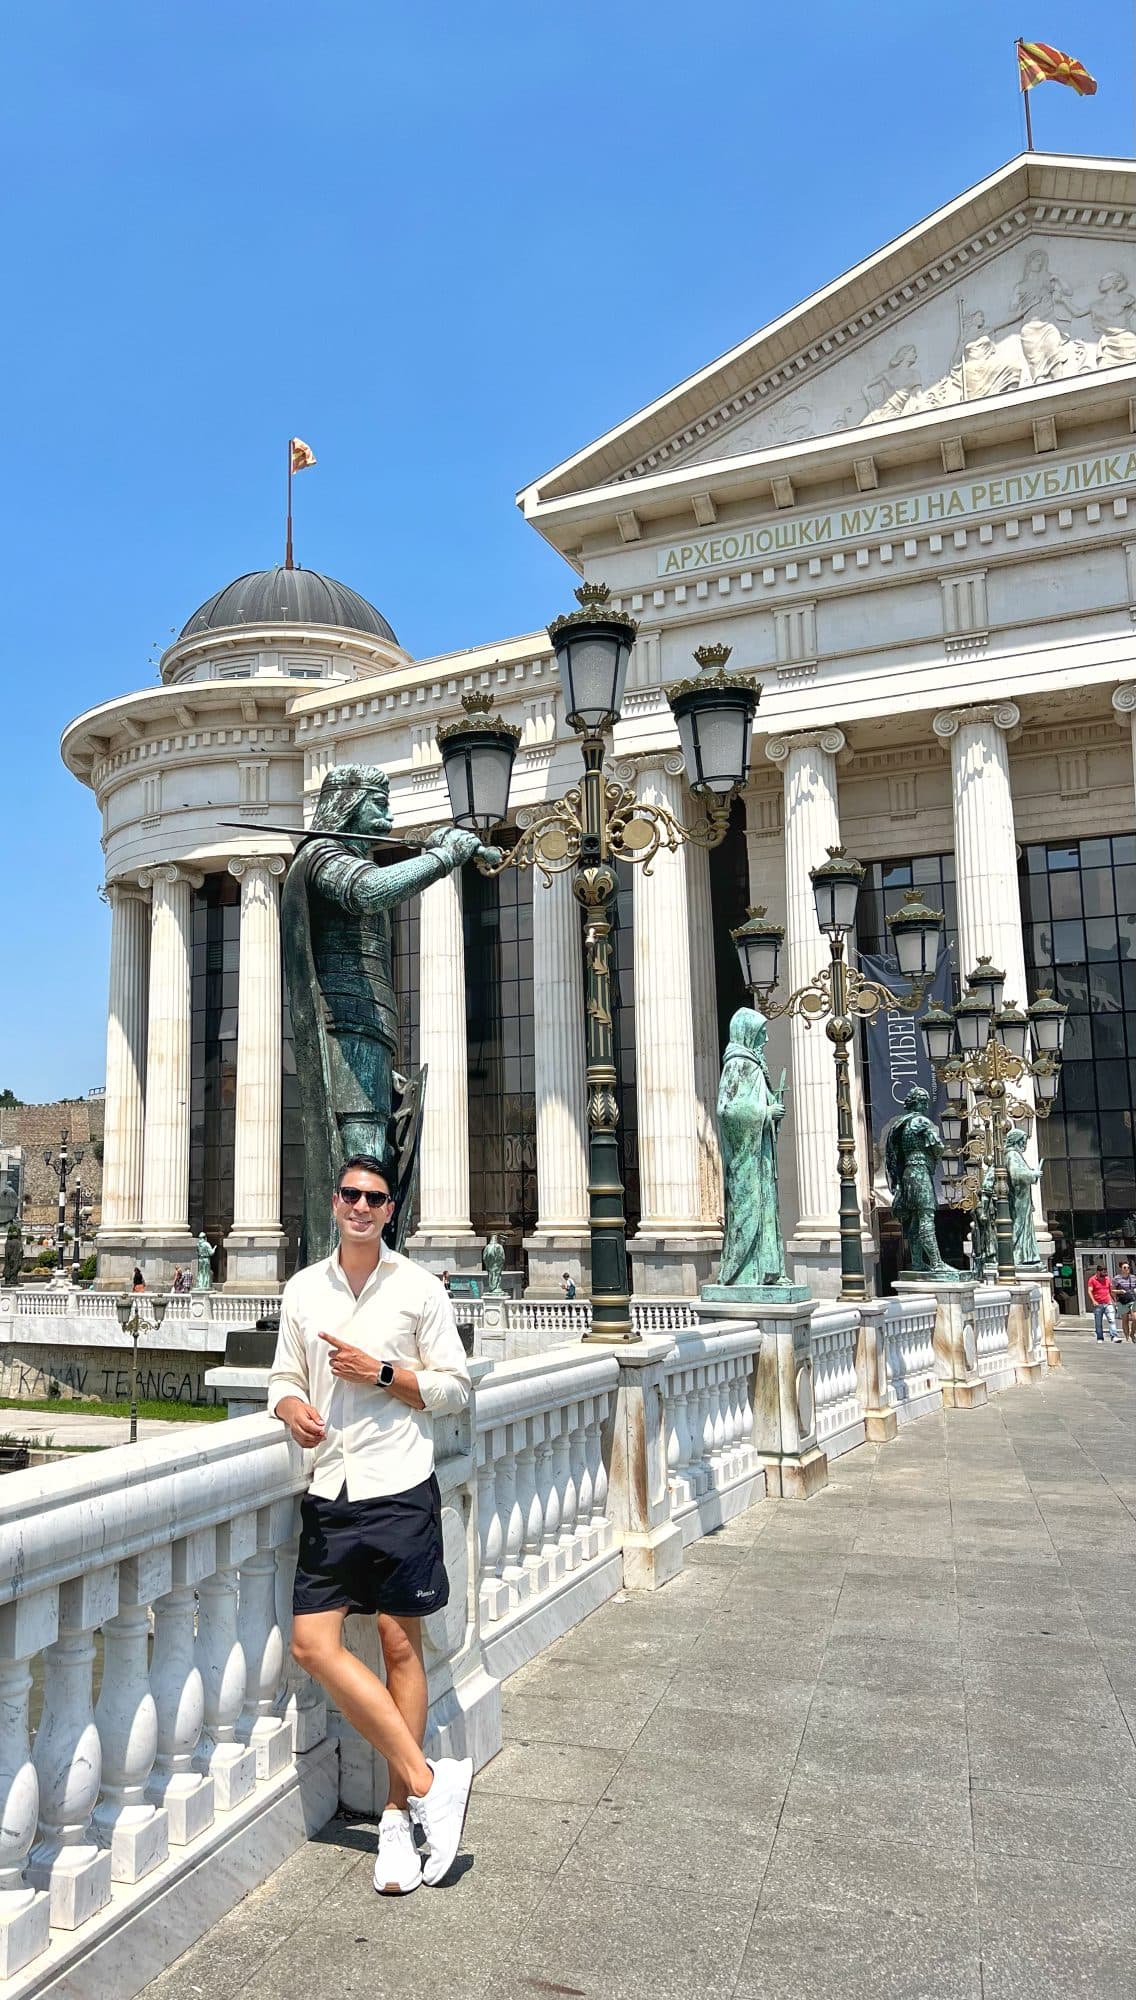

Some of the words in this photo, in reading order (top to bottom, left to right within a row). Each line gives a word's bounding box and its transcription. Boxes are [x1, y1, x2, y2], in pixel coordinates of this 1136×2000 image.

[664, 516, 832, 572] АРХЕОЛОШКИ
[841, 498, 919, 537] МУЗЕЈ
[928, 489, 965, 519] НА
[971, 452, 1136, 510] РЕПУБЛИКА
